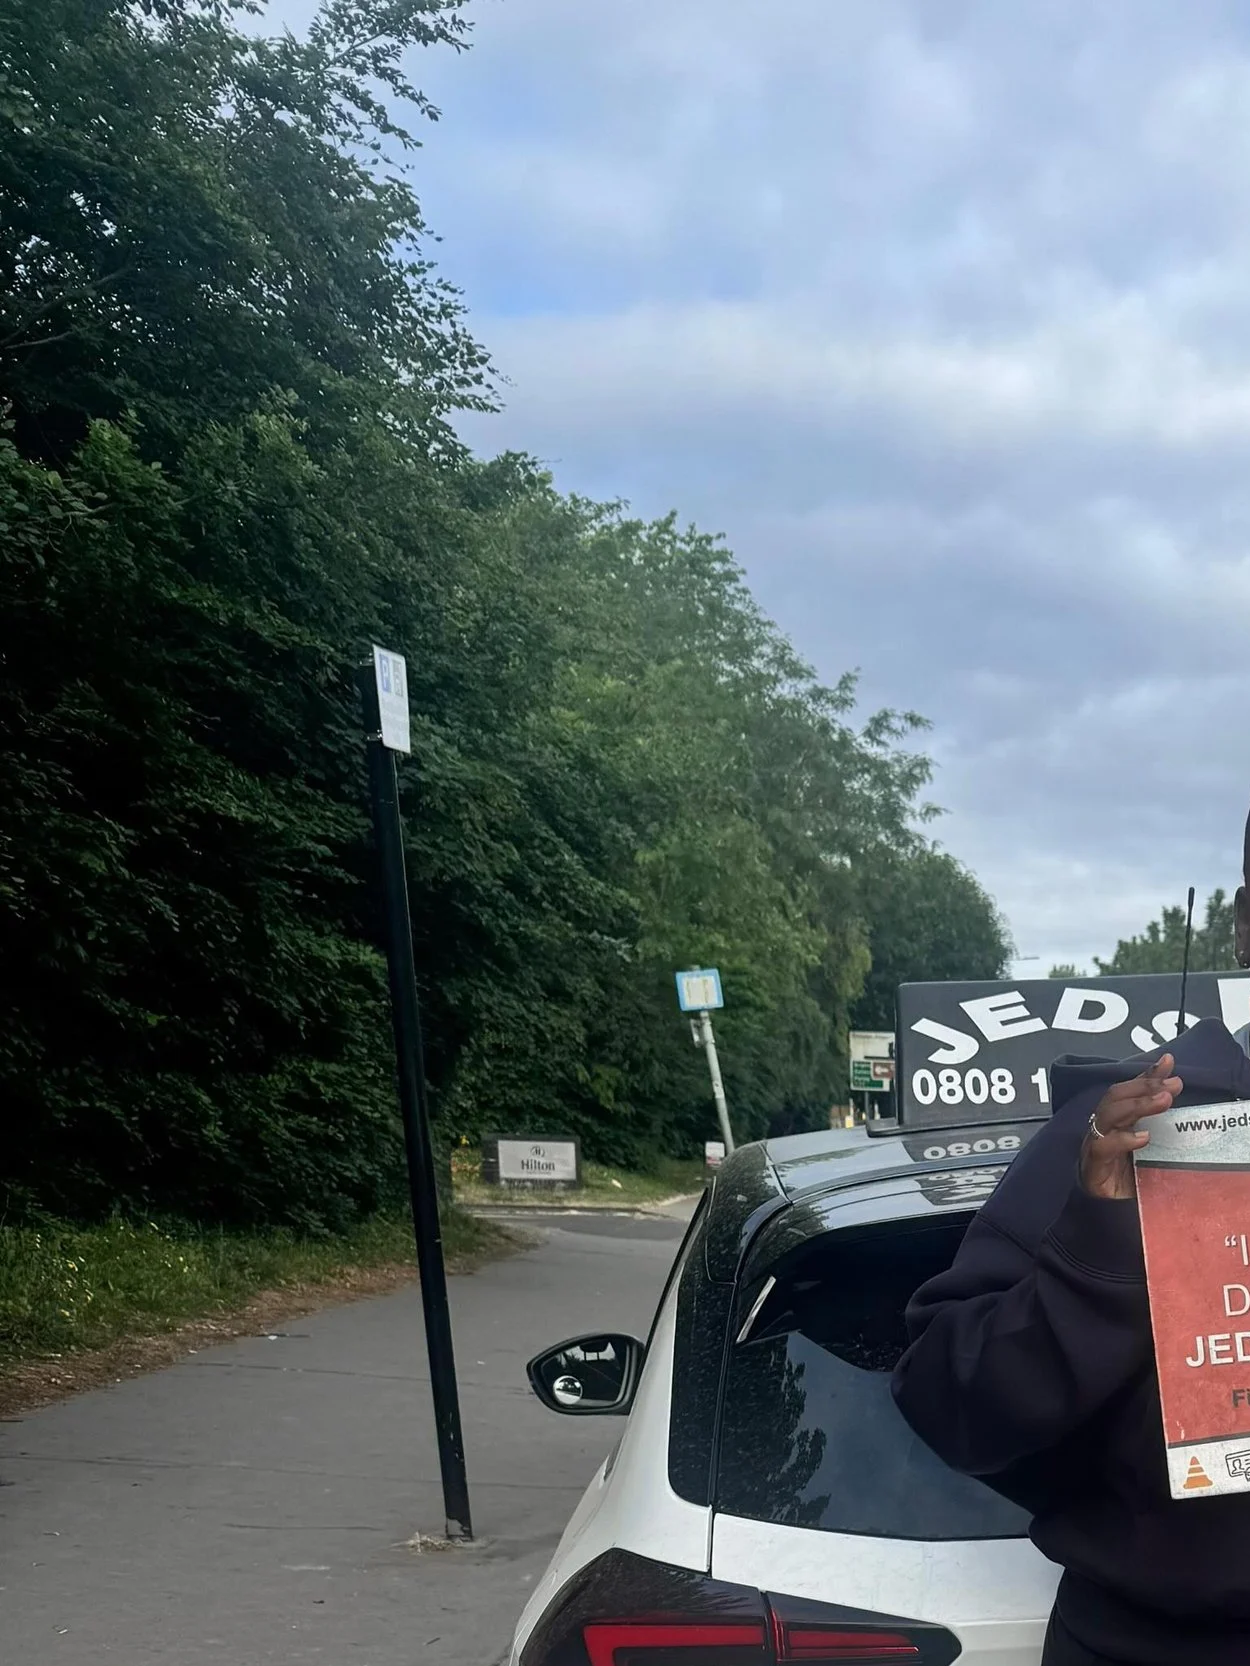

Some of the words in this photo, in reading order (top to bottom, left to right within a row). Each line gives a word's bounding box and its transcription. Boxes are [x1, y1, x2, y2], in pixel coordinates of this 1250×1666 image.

[910, 987, 1201, 1065] JEDS
[912, 1067, 1016, 1105] 0808
[521, 1159, 555, 1171] Hilton
